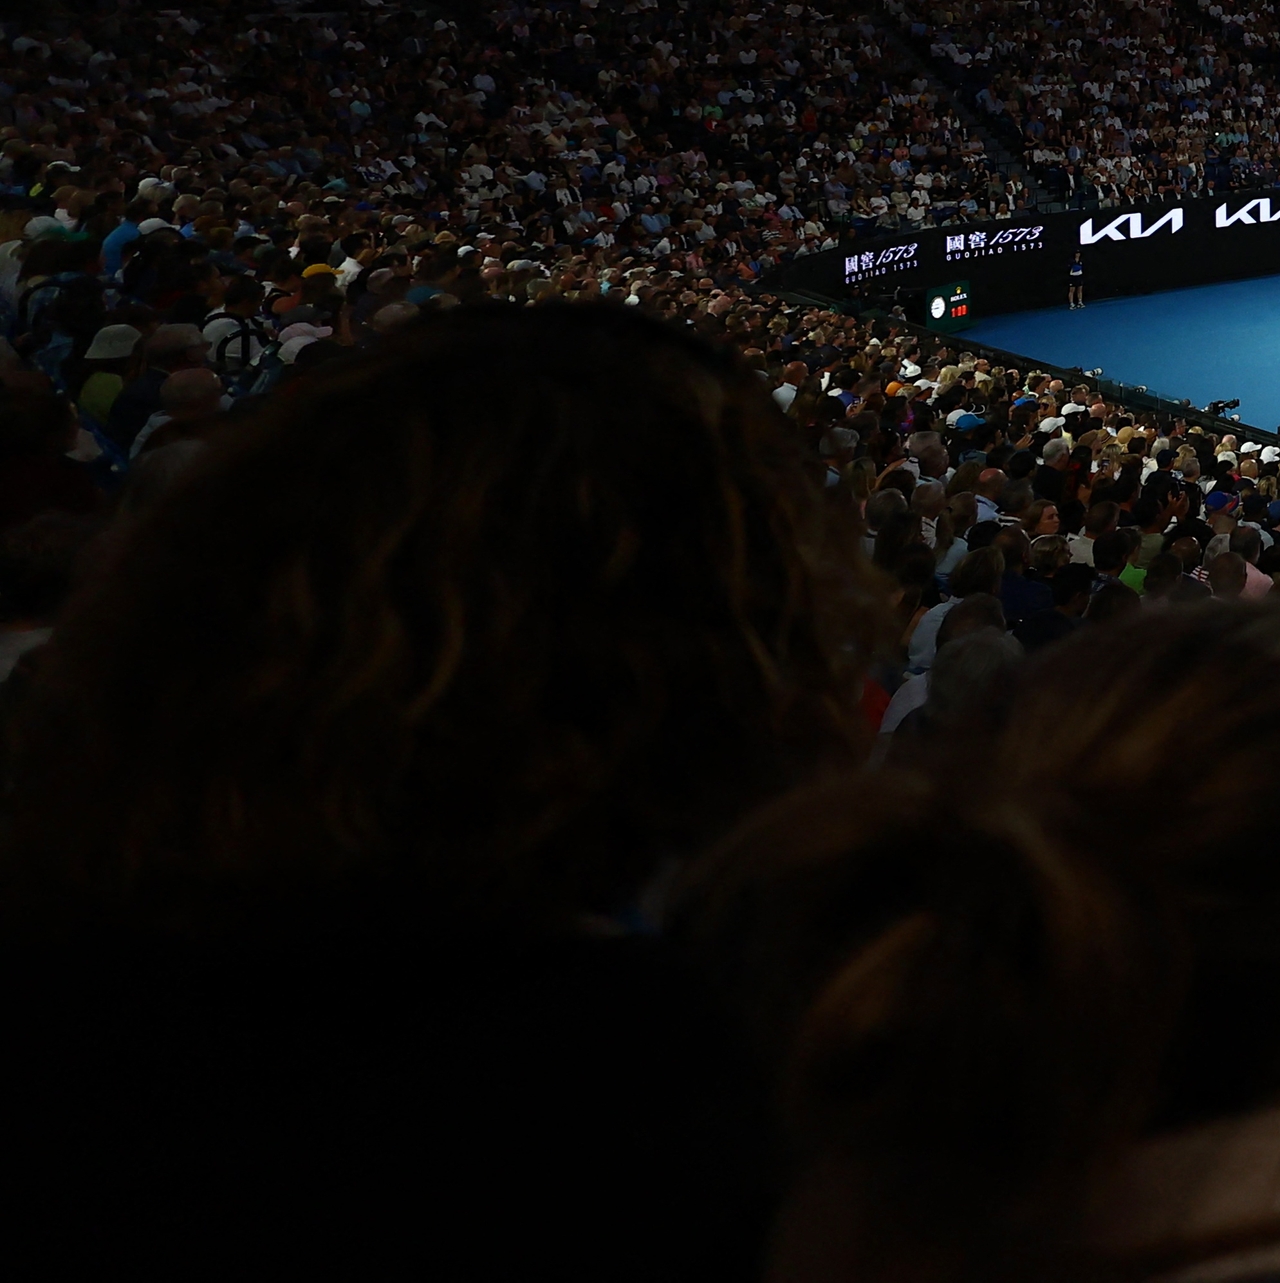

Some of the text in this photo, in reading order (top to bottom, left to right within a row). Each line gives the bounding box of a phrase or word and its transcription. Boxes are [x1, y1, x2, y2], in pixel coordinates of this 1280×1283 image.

[1080, 207, 1184, 245] KIA
[946, 241, 1043, 262] GUOJIAO 1573
[893, 259, 918, 272] 1573
[950, 292, 967, 303] ROLEX
